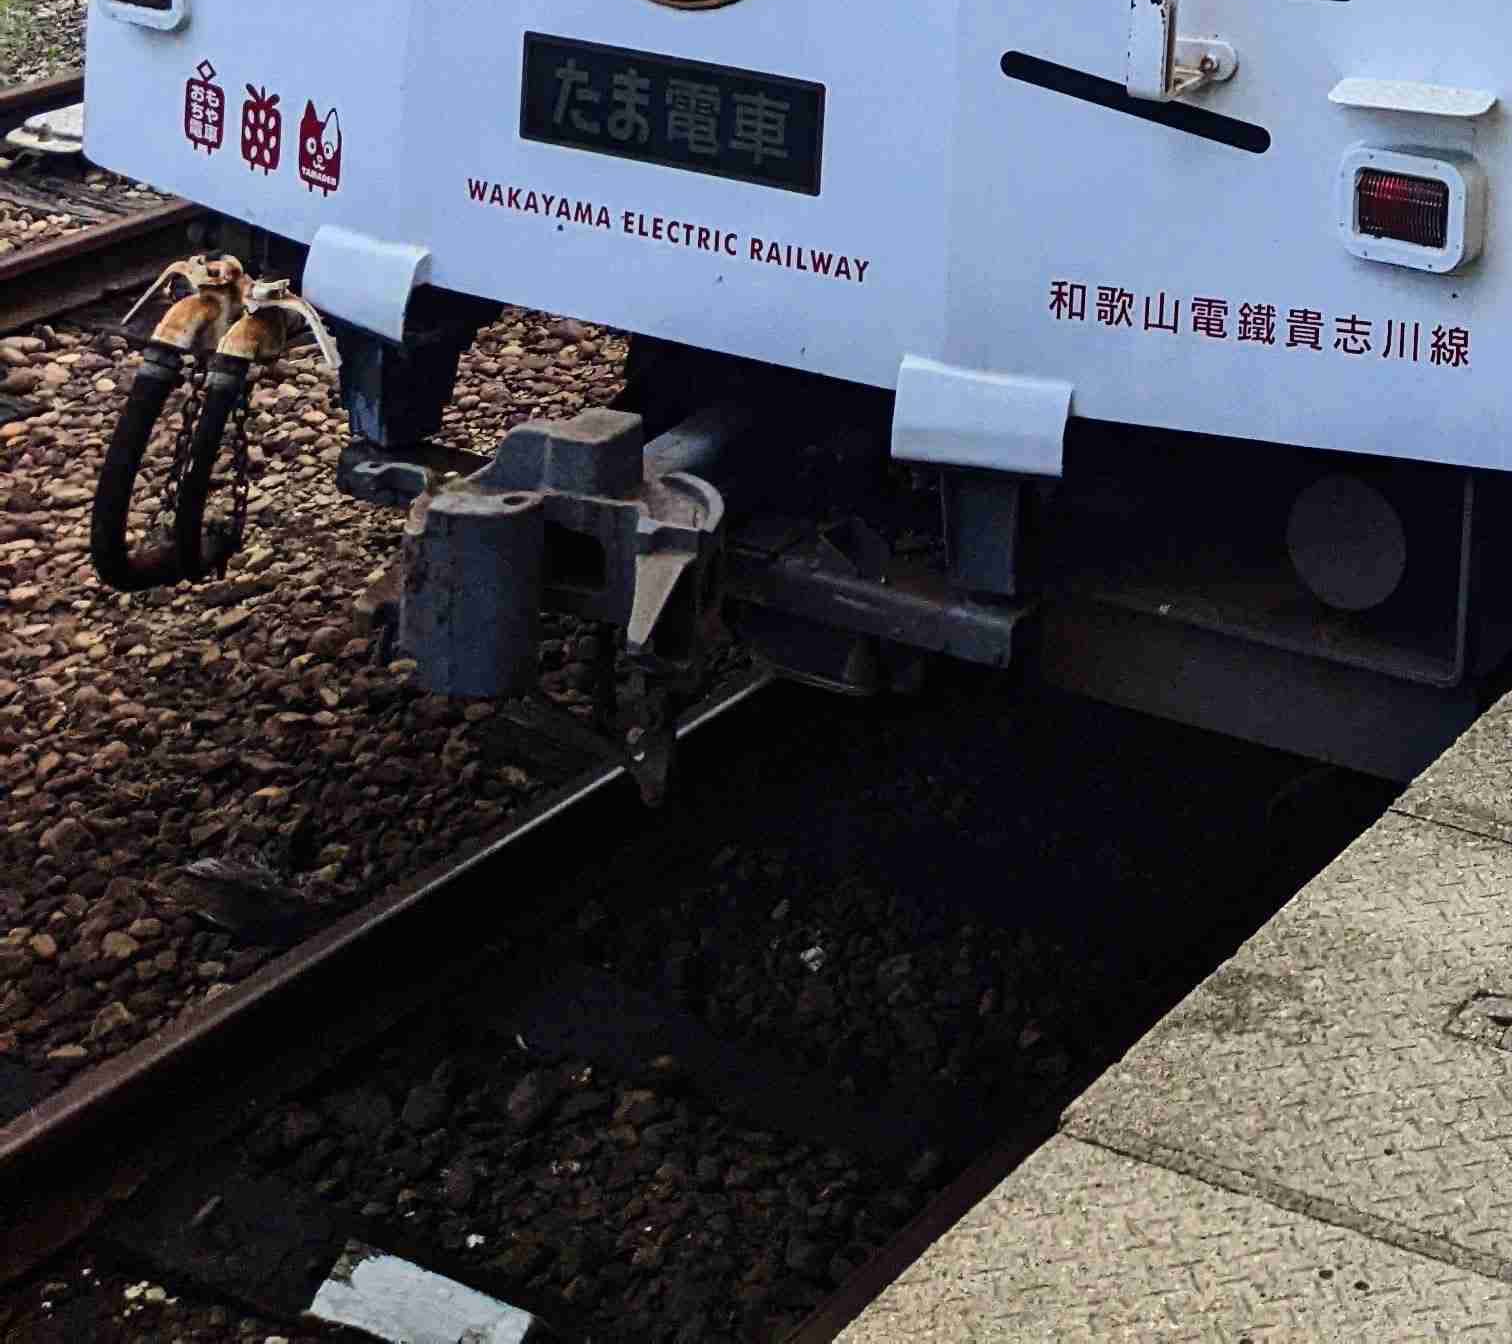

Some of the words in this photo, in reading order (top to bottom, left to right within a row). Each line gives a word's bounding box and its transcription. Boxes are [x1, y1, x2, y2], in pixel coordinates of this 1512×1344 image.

[553, 56, 791, 167] たま電車
[467, 177, 611, 229] WAKAYAMA
[623, 211, 738, 256] ELECTRIC
[750, 237, 870, 283] RAILWAY
[1048, 278, 1472, 368] 和歌山電鐵貴志川線
